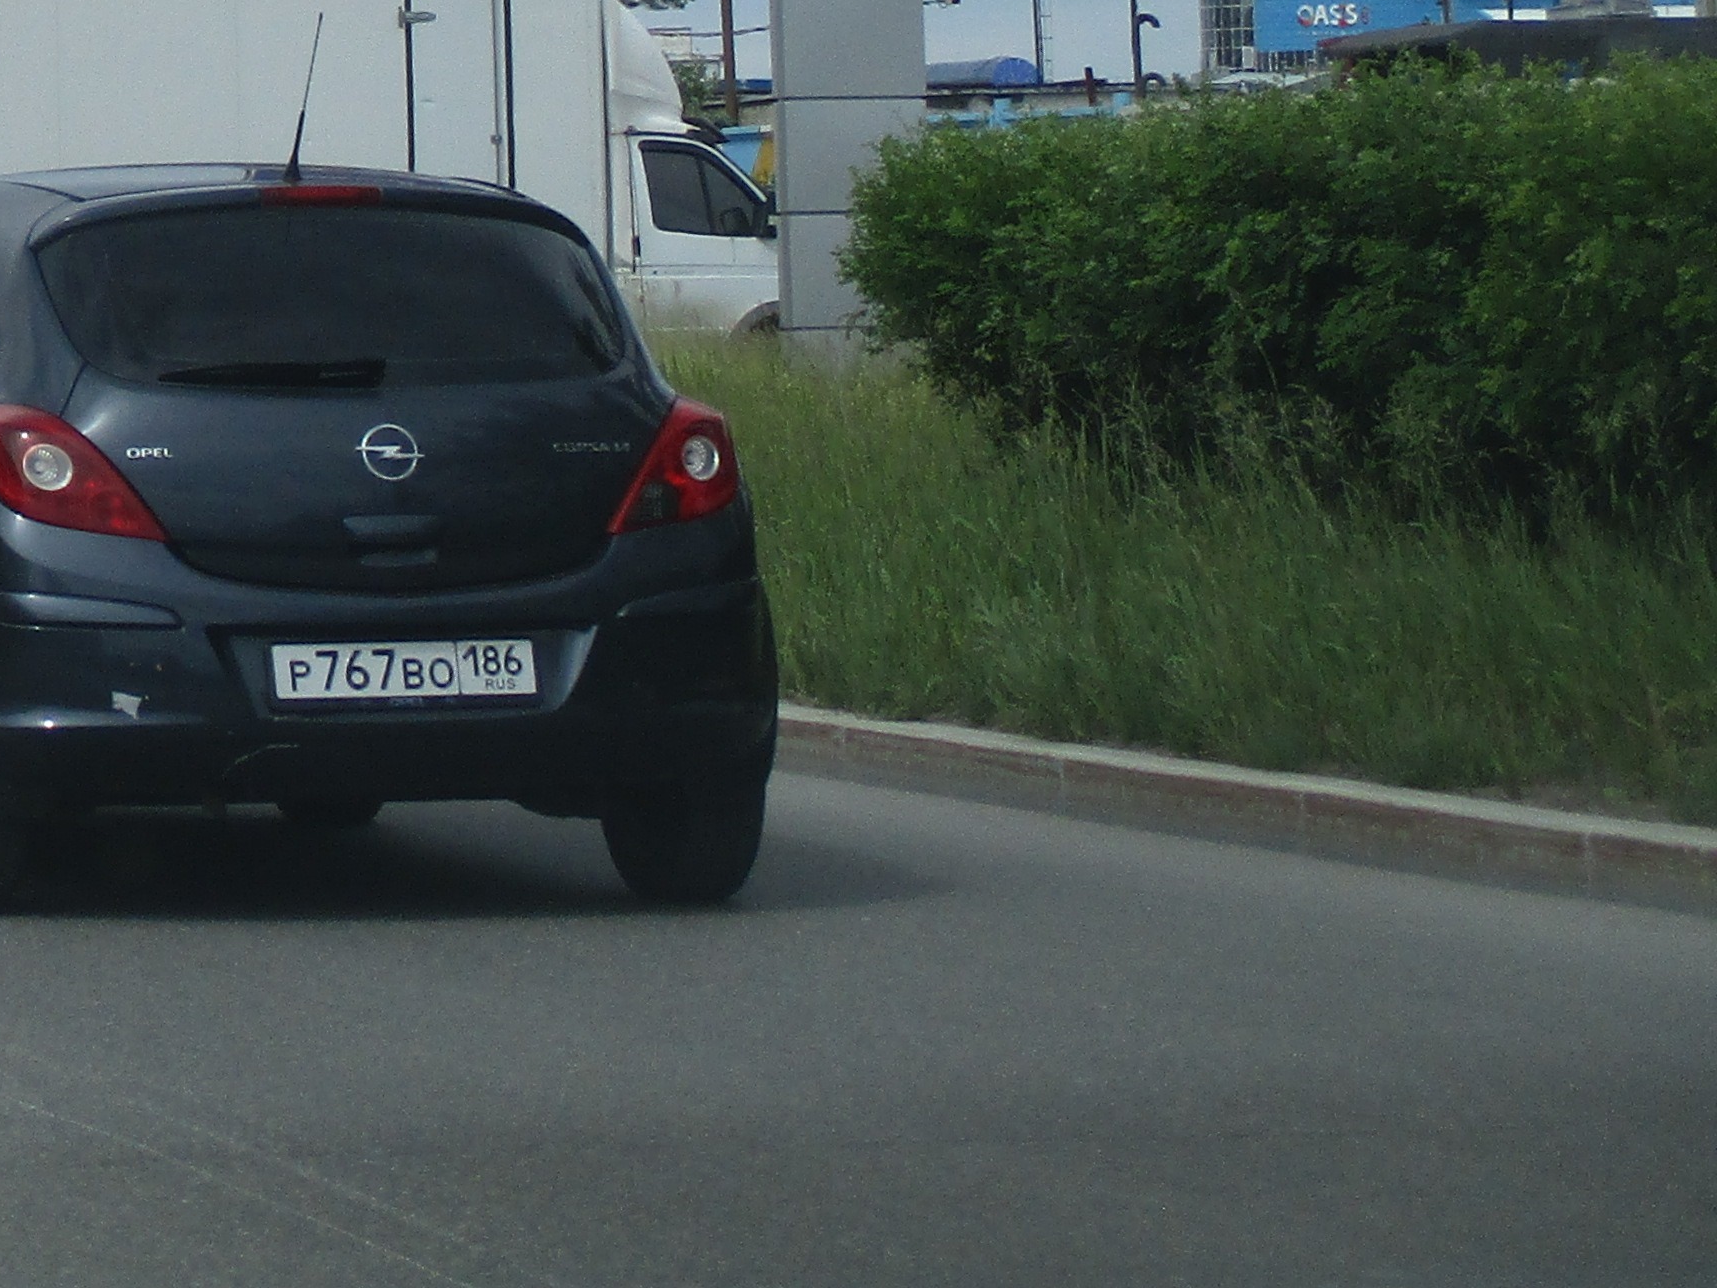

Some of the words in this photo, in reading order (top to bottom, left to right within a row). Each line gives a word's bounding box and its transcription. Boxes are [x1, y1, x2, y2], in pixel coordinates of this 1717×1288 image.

[126, 447, 173, 459] OPEL
[462, 645, 523, 676] 186
[485, 678, 516, 690] RUS
